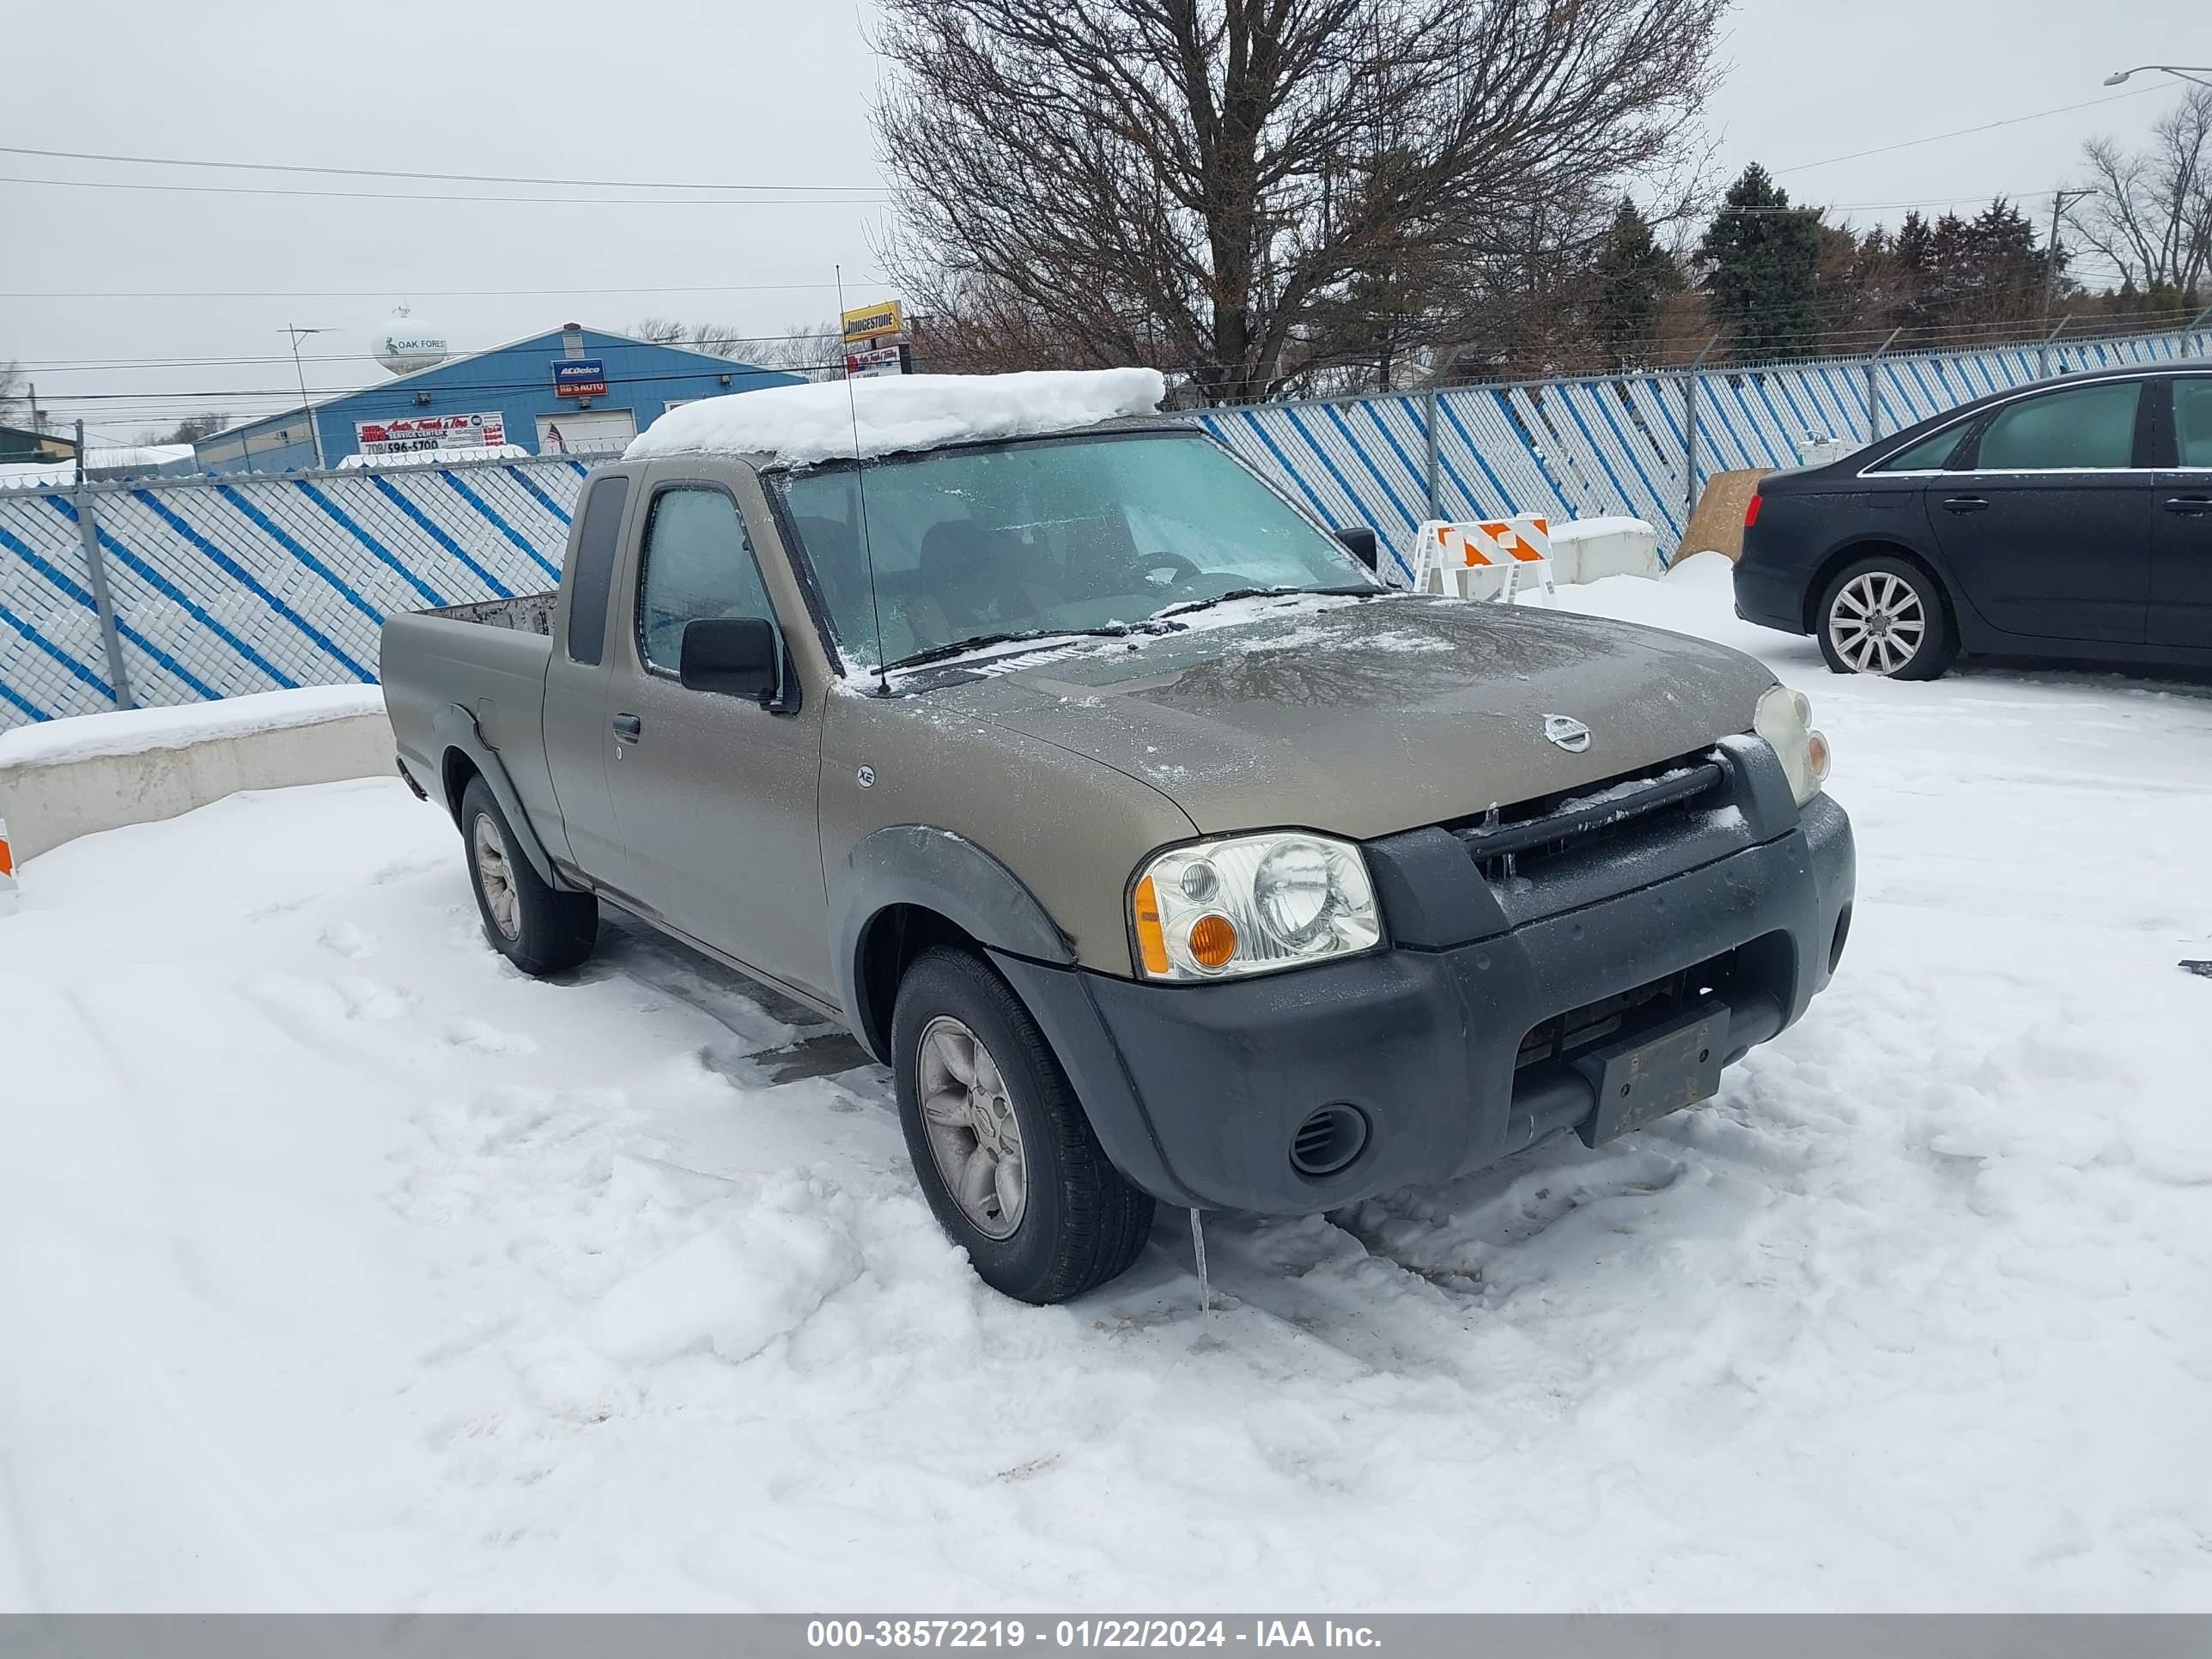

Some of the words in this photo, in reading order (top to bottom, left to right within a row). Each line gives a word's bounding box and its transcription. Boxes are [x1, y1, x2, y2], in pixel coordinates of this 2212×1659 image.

[845, 313, 893, 334] BRIDGESTONE
[398, 340, 418, 349] OAK
[560, 366, 600, 375] ACDelco
[580, 383, 604, 392] AUTO
[859, 769, 873, 784] XE
